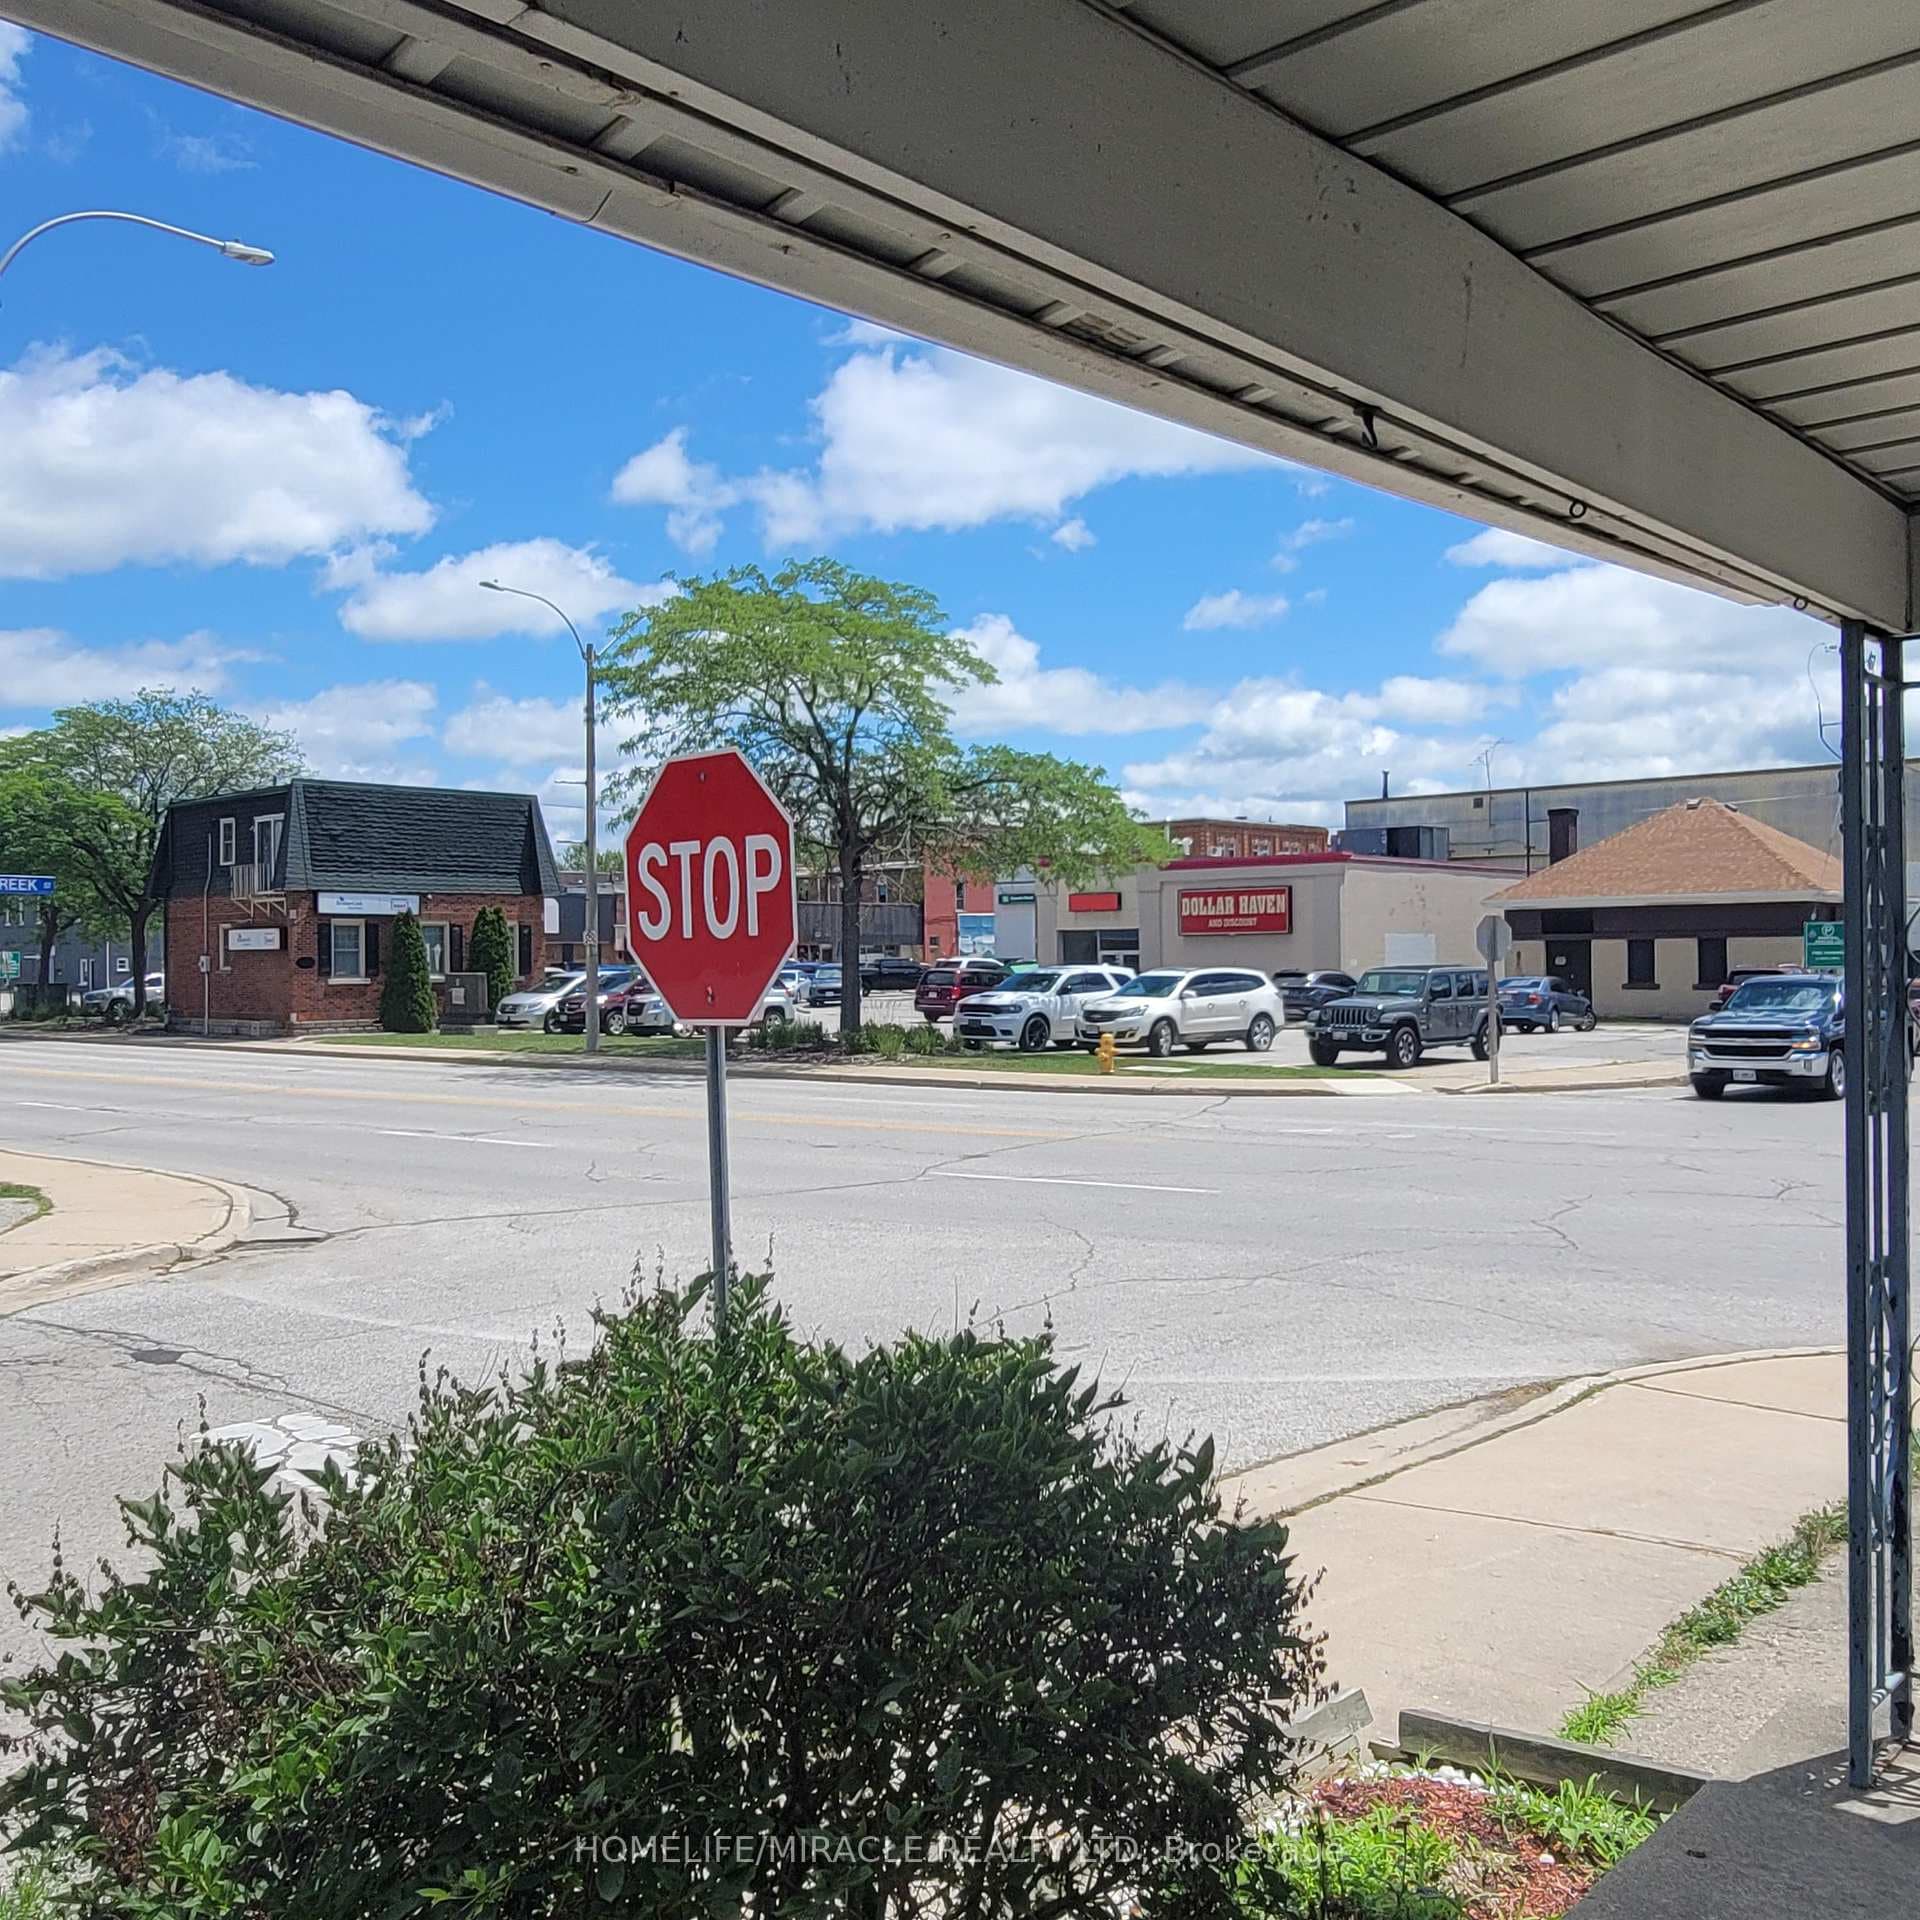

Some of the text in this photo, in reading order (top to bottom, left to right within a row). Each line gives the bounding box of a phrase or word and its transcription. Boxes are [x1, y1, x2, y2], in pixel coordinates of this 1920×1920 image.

[638, 834, 782, 941] STOP
[1182, 894, 1286, 916] DOLLAR HAVEN
